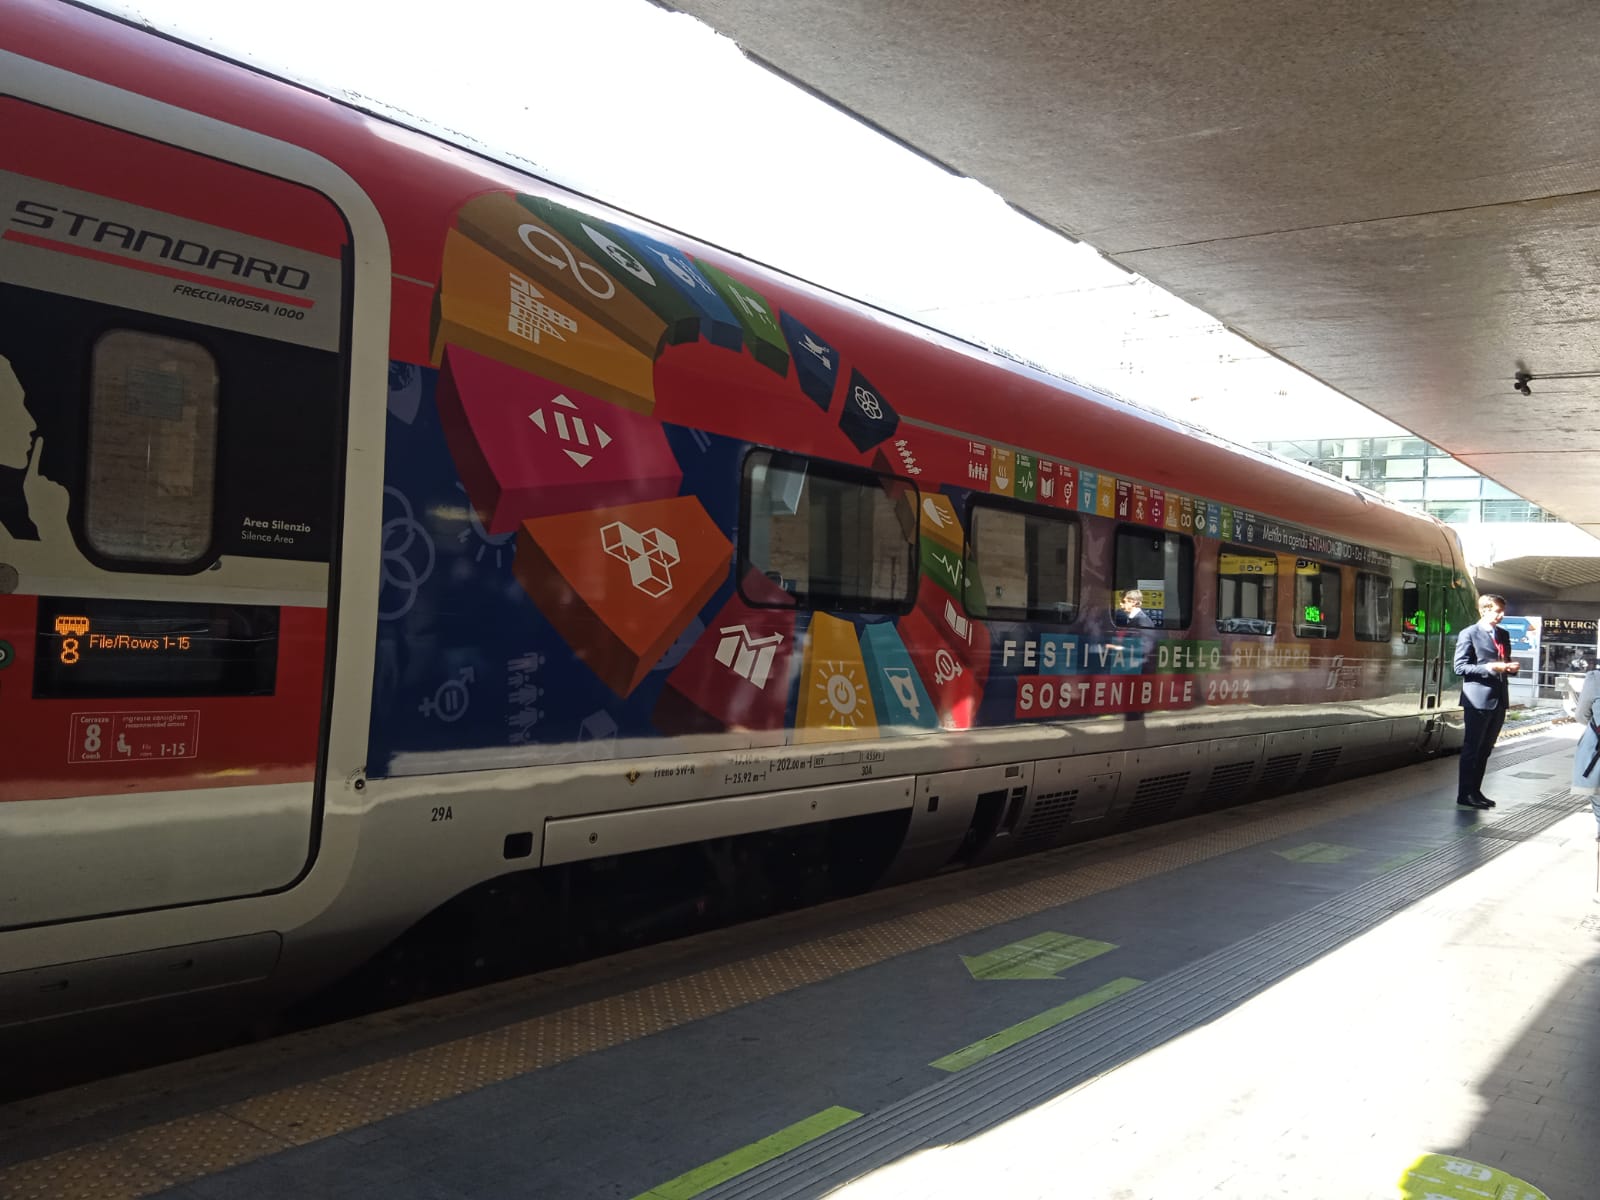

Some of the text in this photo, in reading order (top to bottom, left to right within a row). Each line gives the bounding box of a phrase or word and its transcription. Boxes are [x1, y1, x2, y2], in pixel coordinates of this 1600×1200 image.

[11, 200, 310, 290] STANDARD
[173, 284, 305, 321] FRECCIAROSSA 1000
[241, 530, 294, 544] Silence Area
[243, 517, 312, 533] Area Silenzio
[60, 638, 79, 664] 8
[89, 634, 191, 650] File/Rows 1-15
[1002, 640, 1141, 668] FESTIVAL
[1158, 645, 1222, 669] DELLO
[1020, 679, 1250, 710] SOSTENIBILE 2022
[84, 723, 102, 752] 8
[160, 742, 185, 756] 1-15
[431, 806, 453, 822] 29A
